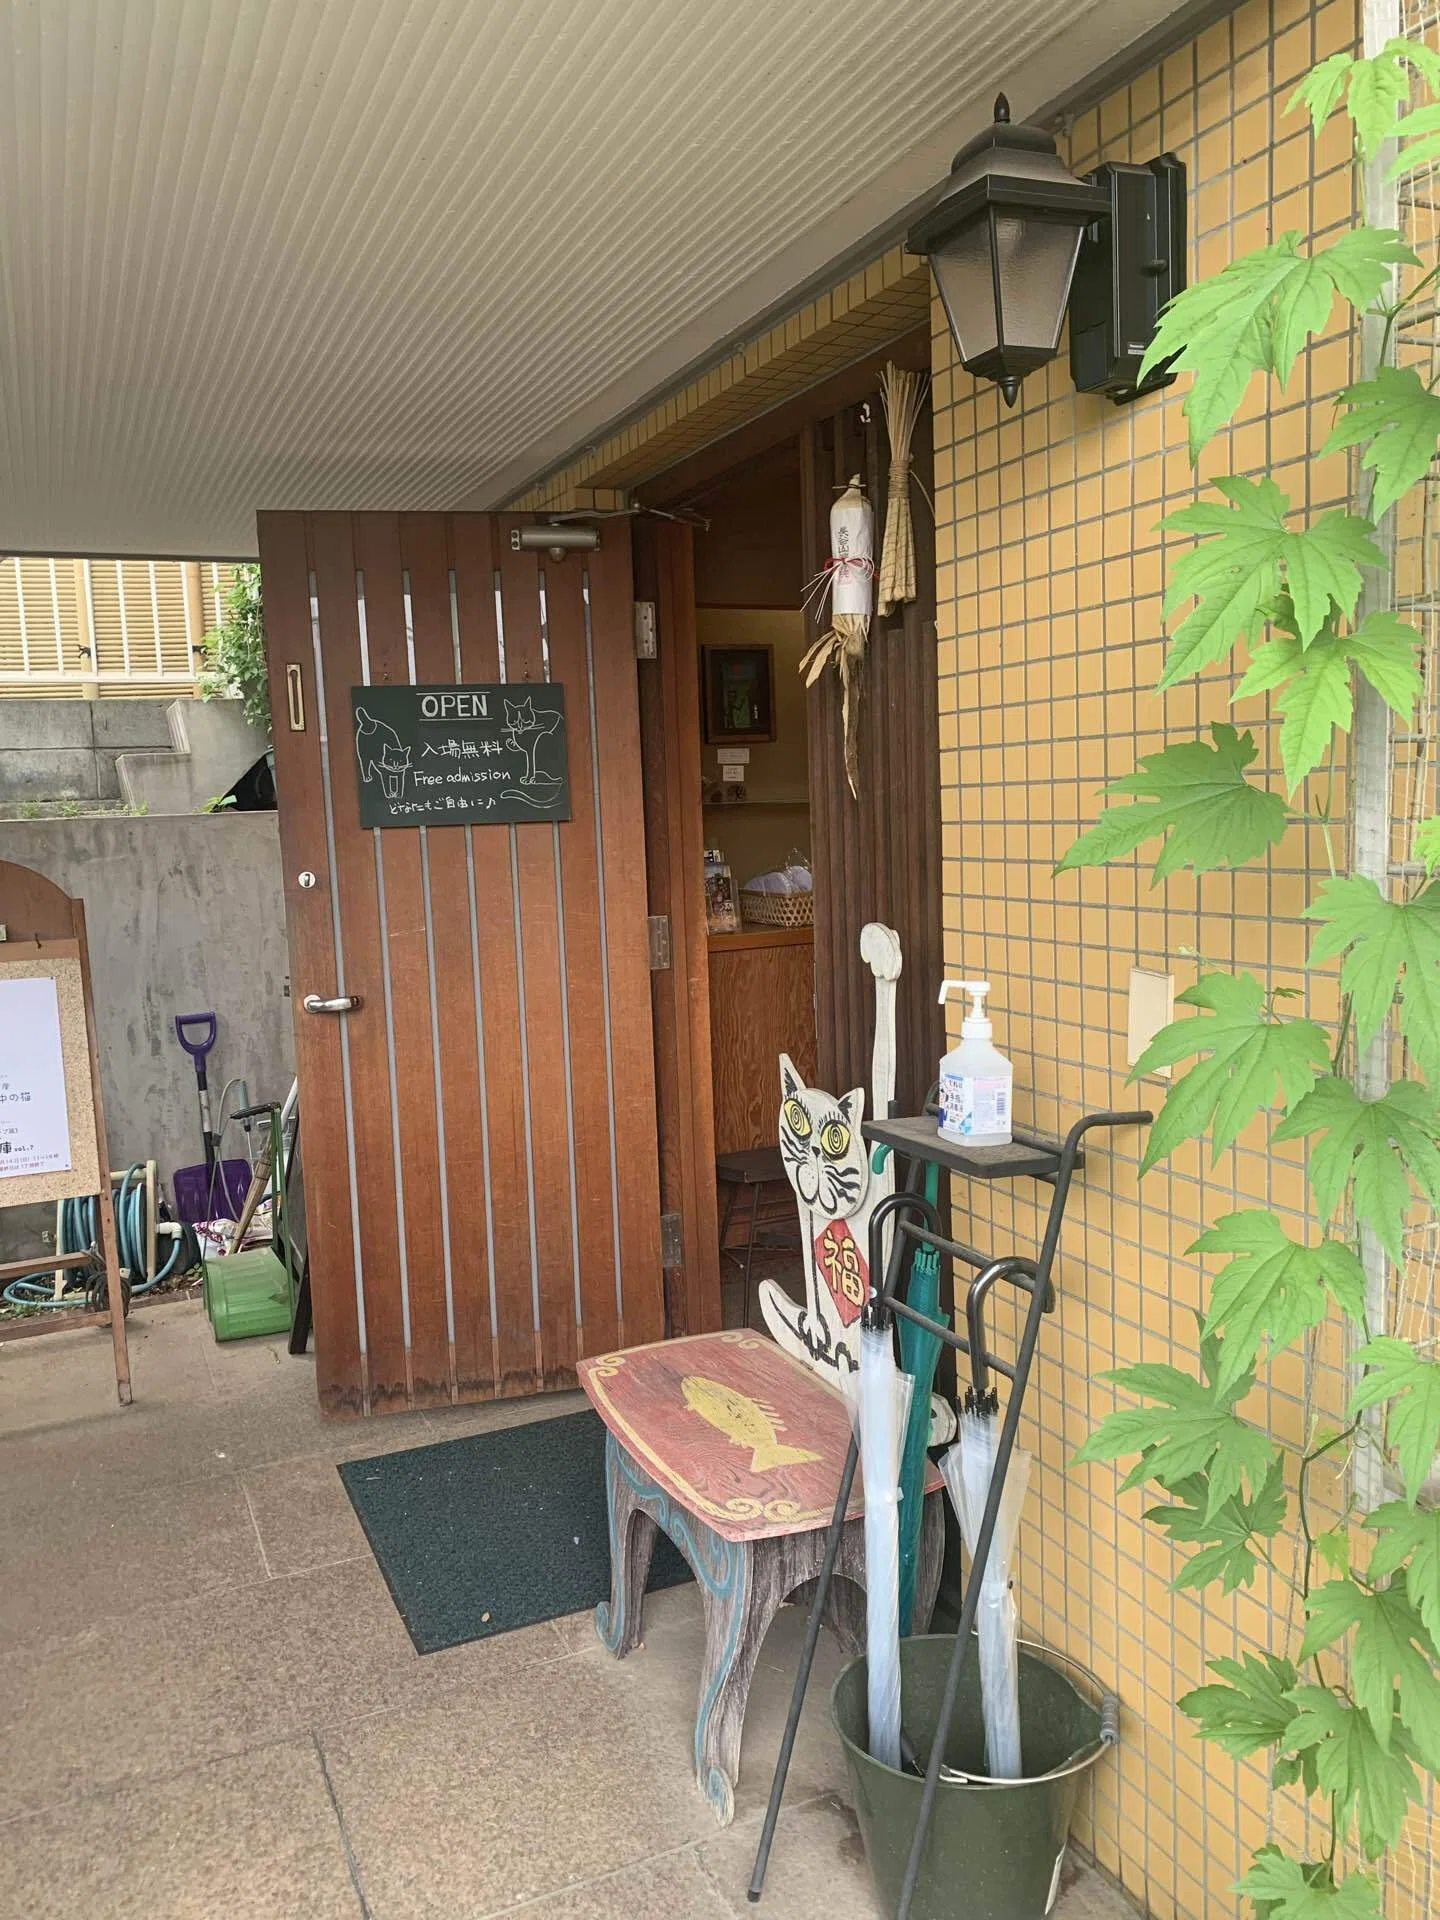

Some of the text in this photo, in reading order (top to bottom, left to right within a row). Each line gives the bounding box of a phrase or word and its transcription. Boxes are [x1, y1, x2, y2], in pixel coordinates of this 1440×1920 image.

[421, 694, 488, 718] OPEN
[421, 739, 503, 759] 入場無料
[413, 765, 512, 787] Free admission
[823, 1228, 865, 1307] 福
